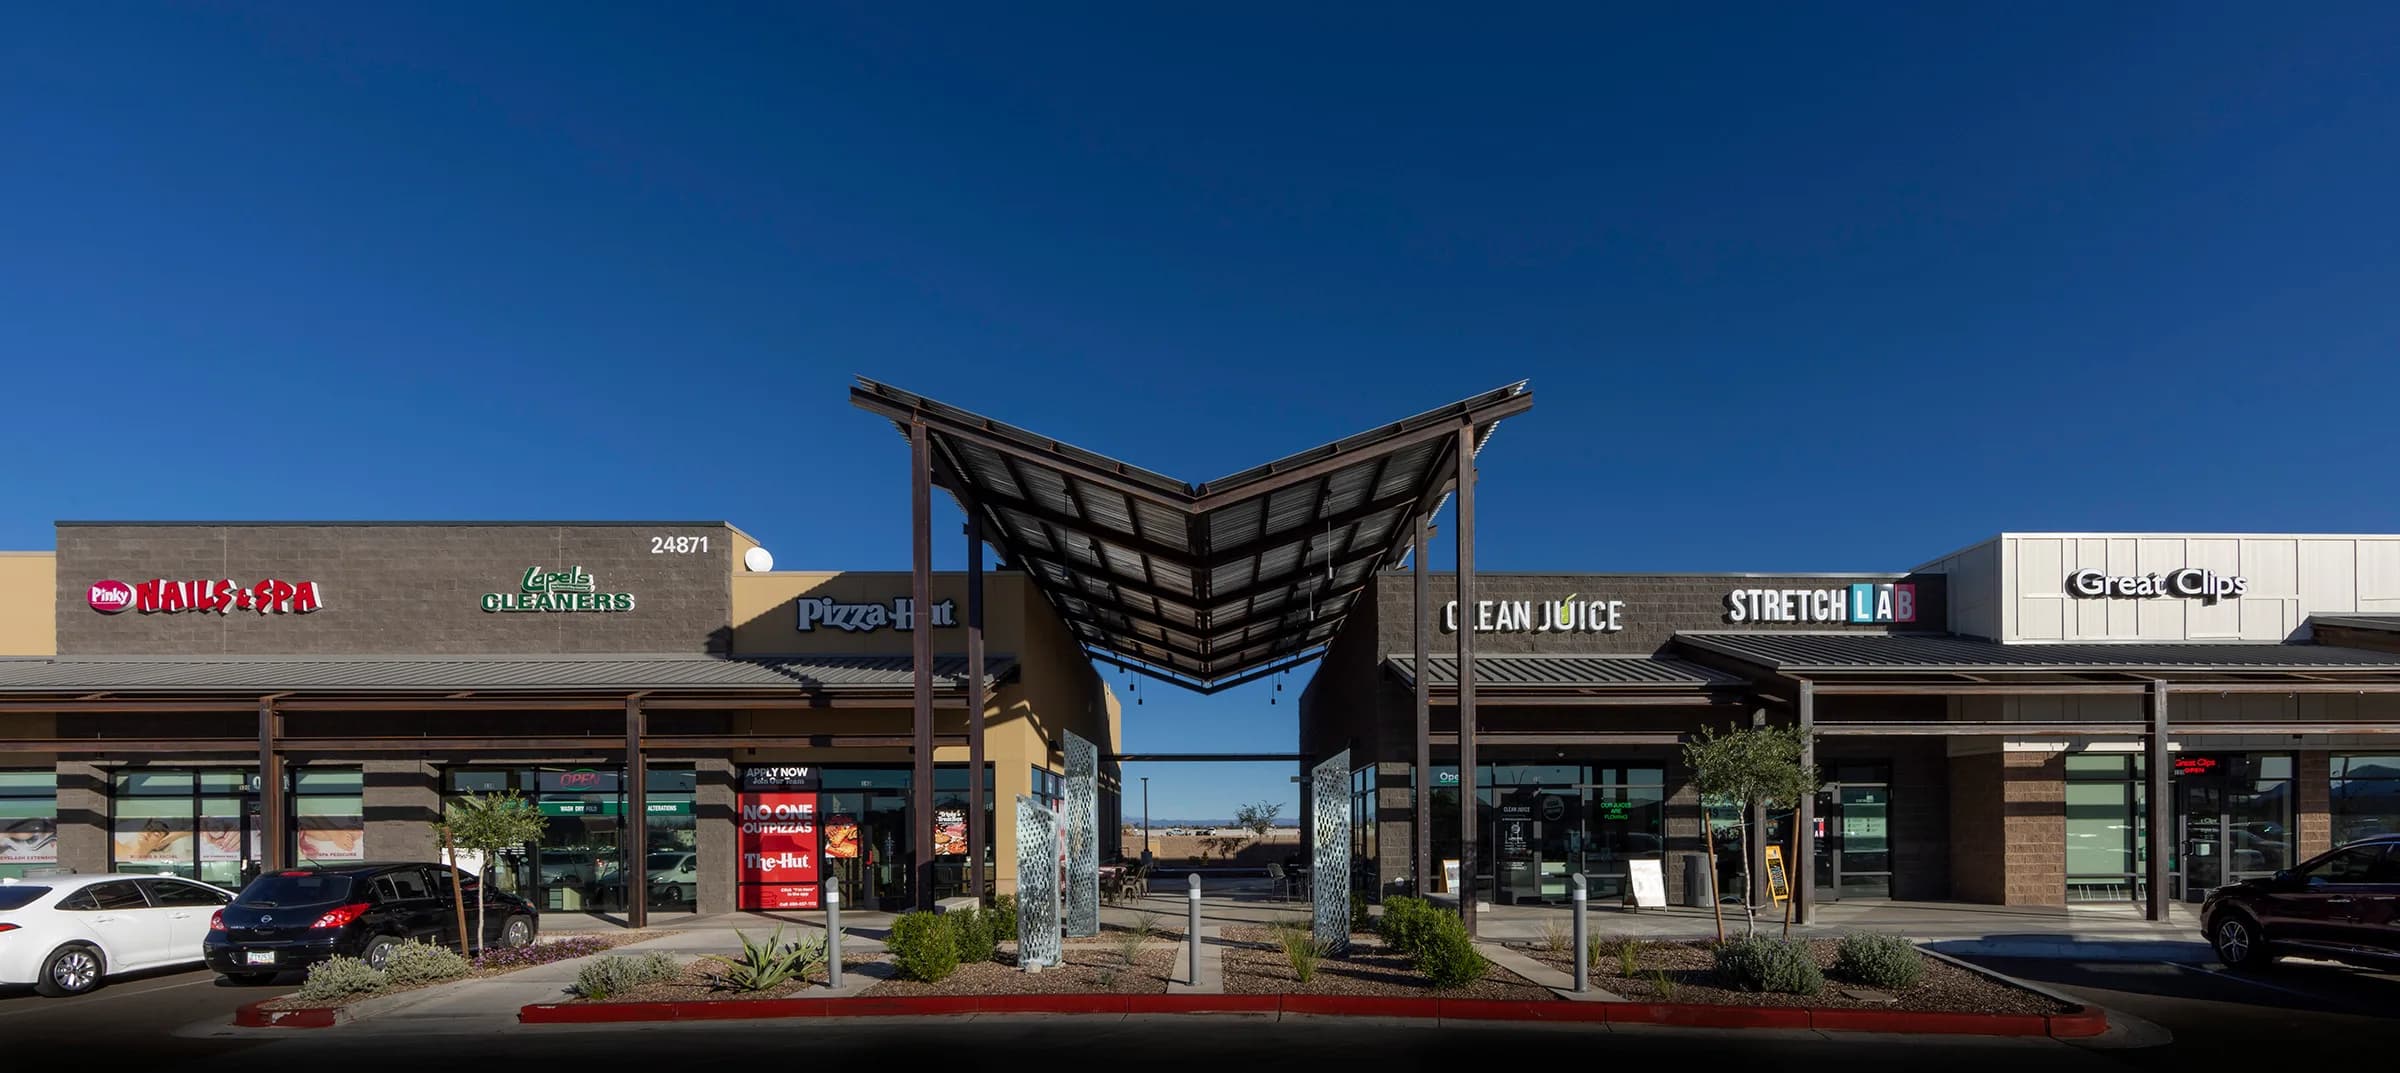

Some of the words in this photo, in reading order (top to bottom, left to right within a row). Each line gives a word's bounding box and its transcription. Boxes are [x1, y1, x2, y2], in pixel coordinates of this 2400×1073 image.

[650, 536, 709, 554] 24871
[522, 565, 593, 593] Lapels
[2076, 569, 2168, 597] Great
[2176, 569, 2248, 601] Clips
[91, 586, 129, 605] Pinky
[136, 578, 237, 615] NAILS
[236, 587, 257, 611] &
[253, 578, 323, 615] SPA
[481, 592, 635, 613] CLEANERS
[798, 598, 888, 632] Pizza
[1446, 600, 1531, 631] CEAN
[1538, 593, 1624, 631] JUICE
[560, 772, 600, 787] OPEN
[747, 767, 778, 777] APPLY
[781, 767, 808, 777] NOW
[769, 777, 784, 785] Our
[1439, 771, 1460, 782] Ope
[743, 804, 772, 820] NO
[775, 804, 813, 820] ONE
[742, 822, 813, 834] OUTPIZZAS
[744, 853, 777, 872] The
[778, 852, 811, 869] Hut
